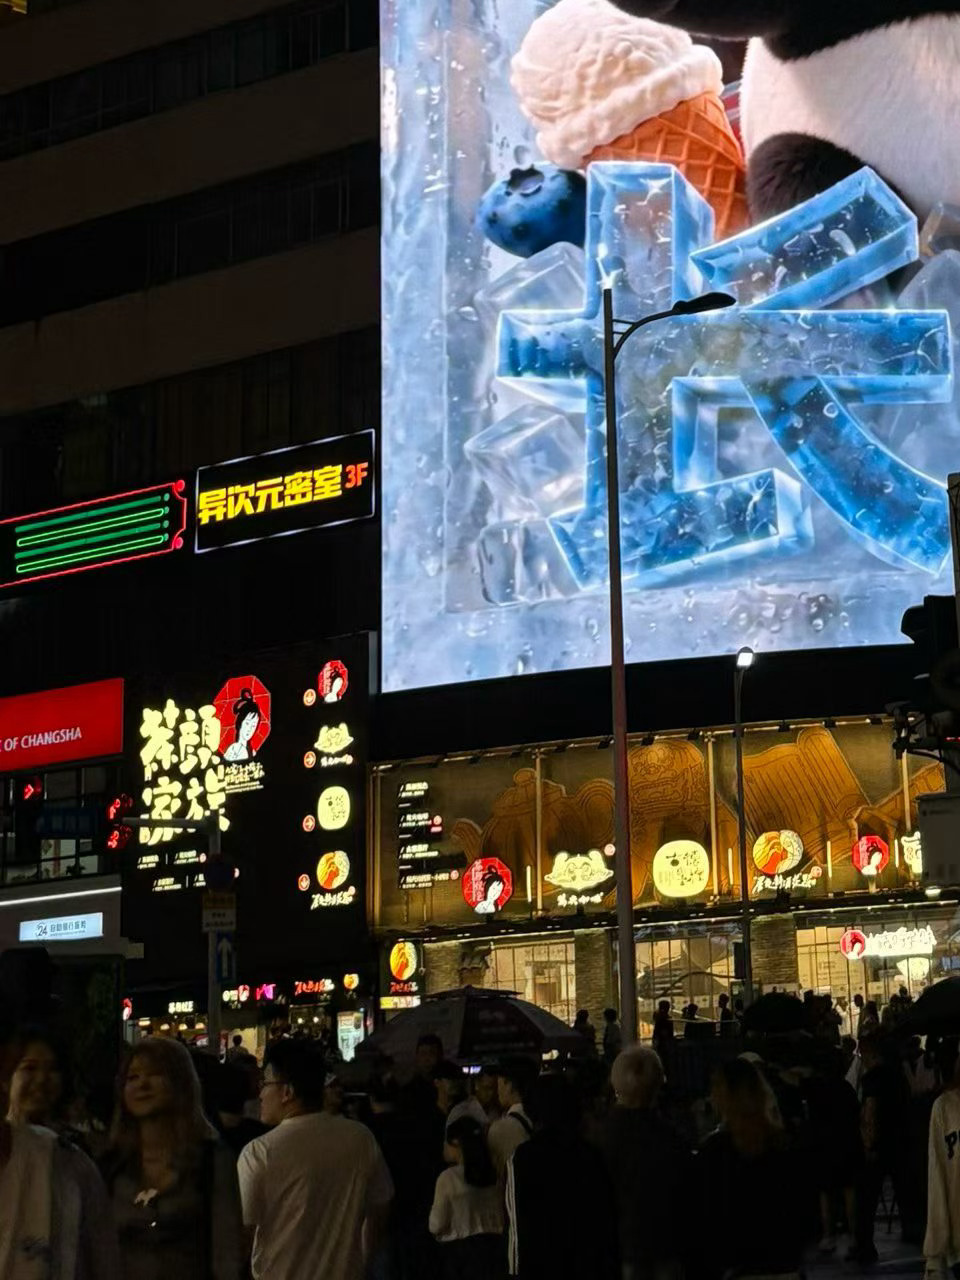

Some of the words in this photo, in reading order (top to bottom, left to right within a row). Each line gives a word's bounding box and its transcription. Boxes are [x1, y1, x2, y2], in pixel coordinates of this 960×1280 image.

[198, 464, 343, 525] 异次元密室
[345, 461, 369, 489] 3F
[3, 737, 18, 752] OF
[20, 726, 83, 749] CHANGSHA
